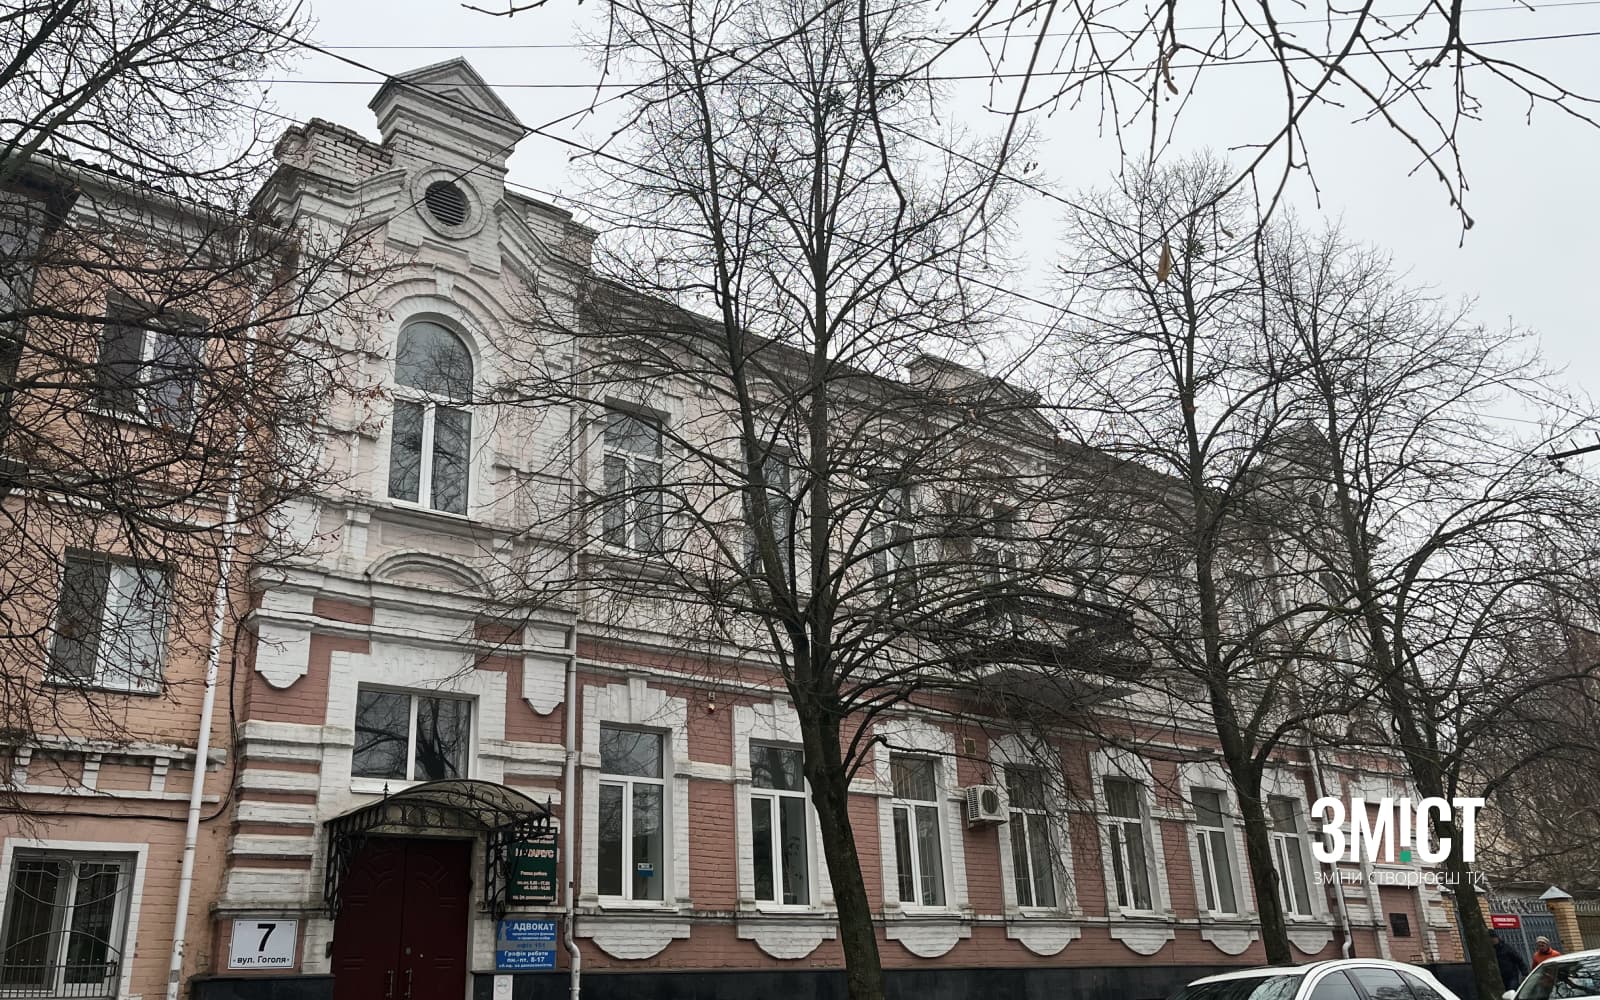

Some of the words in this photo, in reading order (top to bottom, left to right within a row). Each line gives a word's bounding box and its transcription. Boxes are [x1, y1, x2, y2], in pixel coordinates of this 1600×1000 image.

[513, 922, 555, 932] АДВОКАТ
[257, 923, 277, 952] 7
[237, 957, 255, 965] вул.
[257, 955, 287, 963] Гоголя
